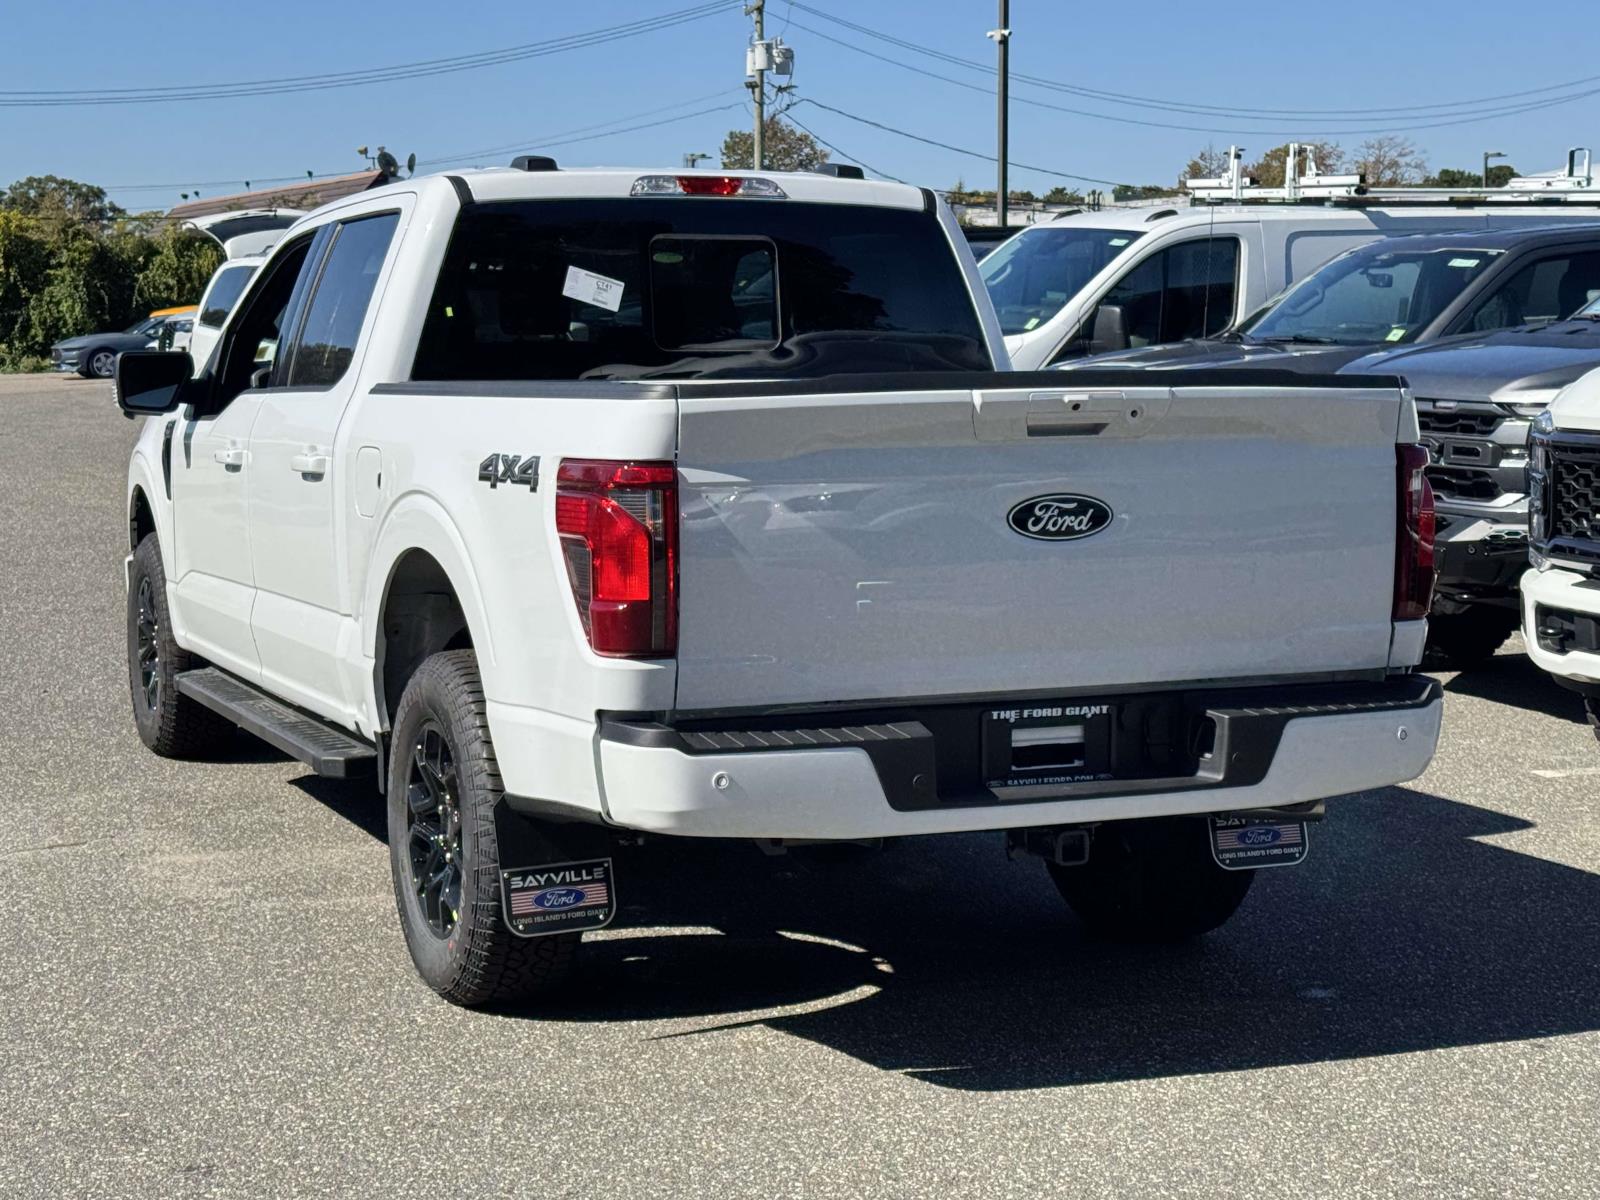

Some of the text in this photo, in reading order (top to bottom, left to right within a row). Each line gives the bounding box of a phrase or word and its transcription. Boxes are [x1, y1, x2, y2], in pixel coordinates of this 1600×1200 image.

[1027, 501, 1094, 532] Ford
[992, 705, 1109, 720] THE FORD GIANT
[1007, 775, 1094, 785] SAYVILLEFORDCOM
[1245, 829, 1273, 843] Ford
[1283, 847, 1302, 855] GIANT
[510, 867, 605, 889] SAYVILLE
[544, 890, 576, 907] Ford
[512, 907, 609, 926] LONG ISLAND'S FORD GIANT
